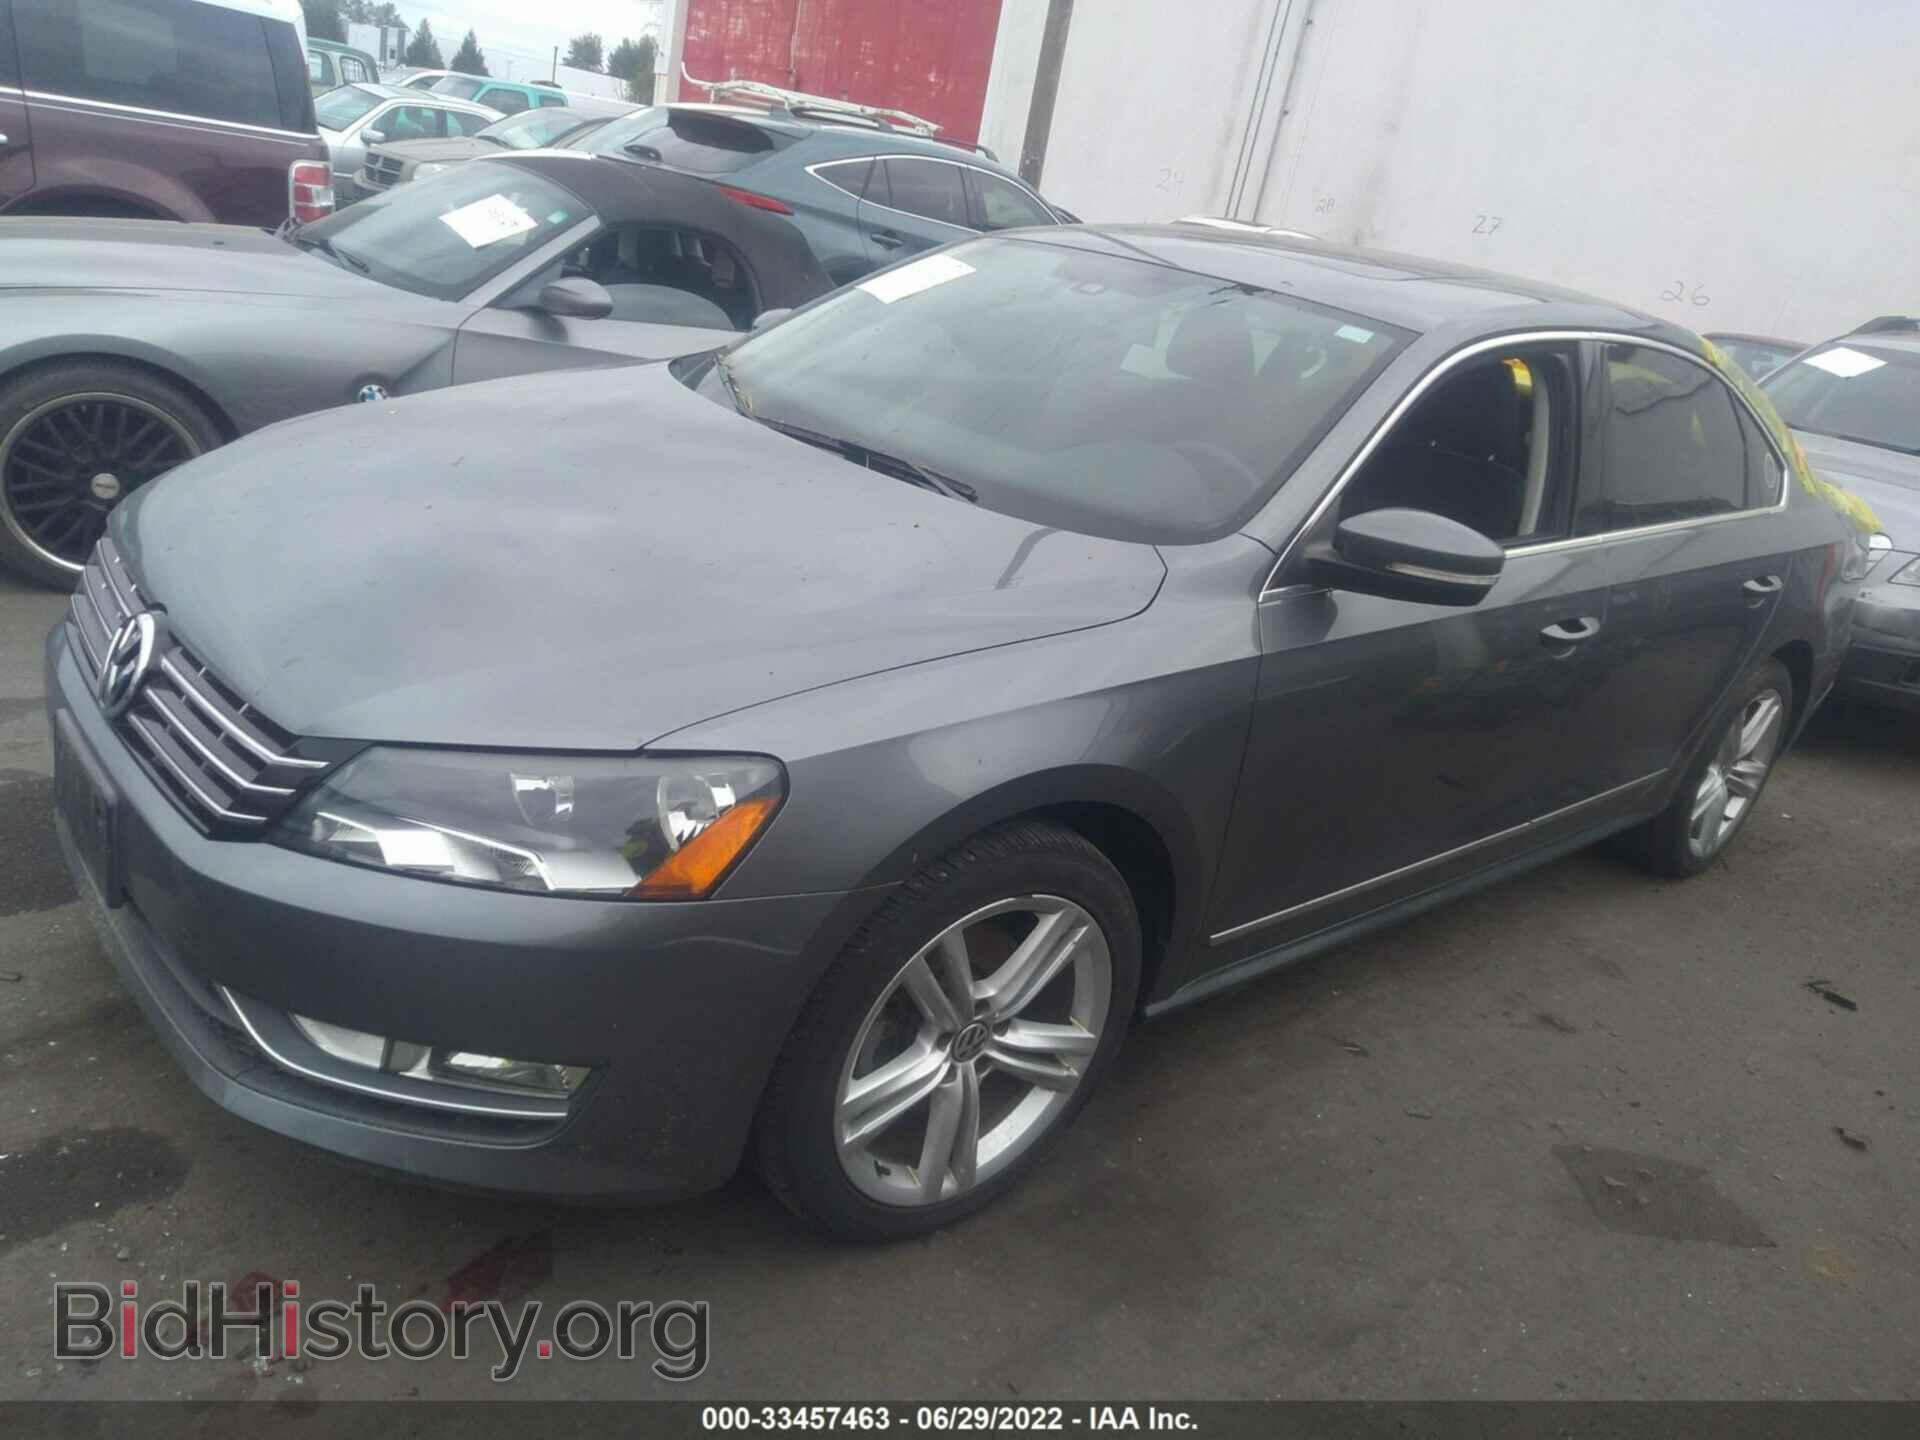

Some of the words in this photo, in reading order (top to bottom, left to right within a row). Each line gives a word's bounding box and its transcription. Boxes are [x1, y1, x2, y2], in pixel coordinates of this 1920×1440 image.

[1314, 197, 1336, 215] 28
[1471, 214, 1503, 235] 27
[1657, 280, 1712, 306] 26
